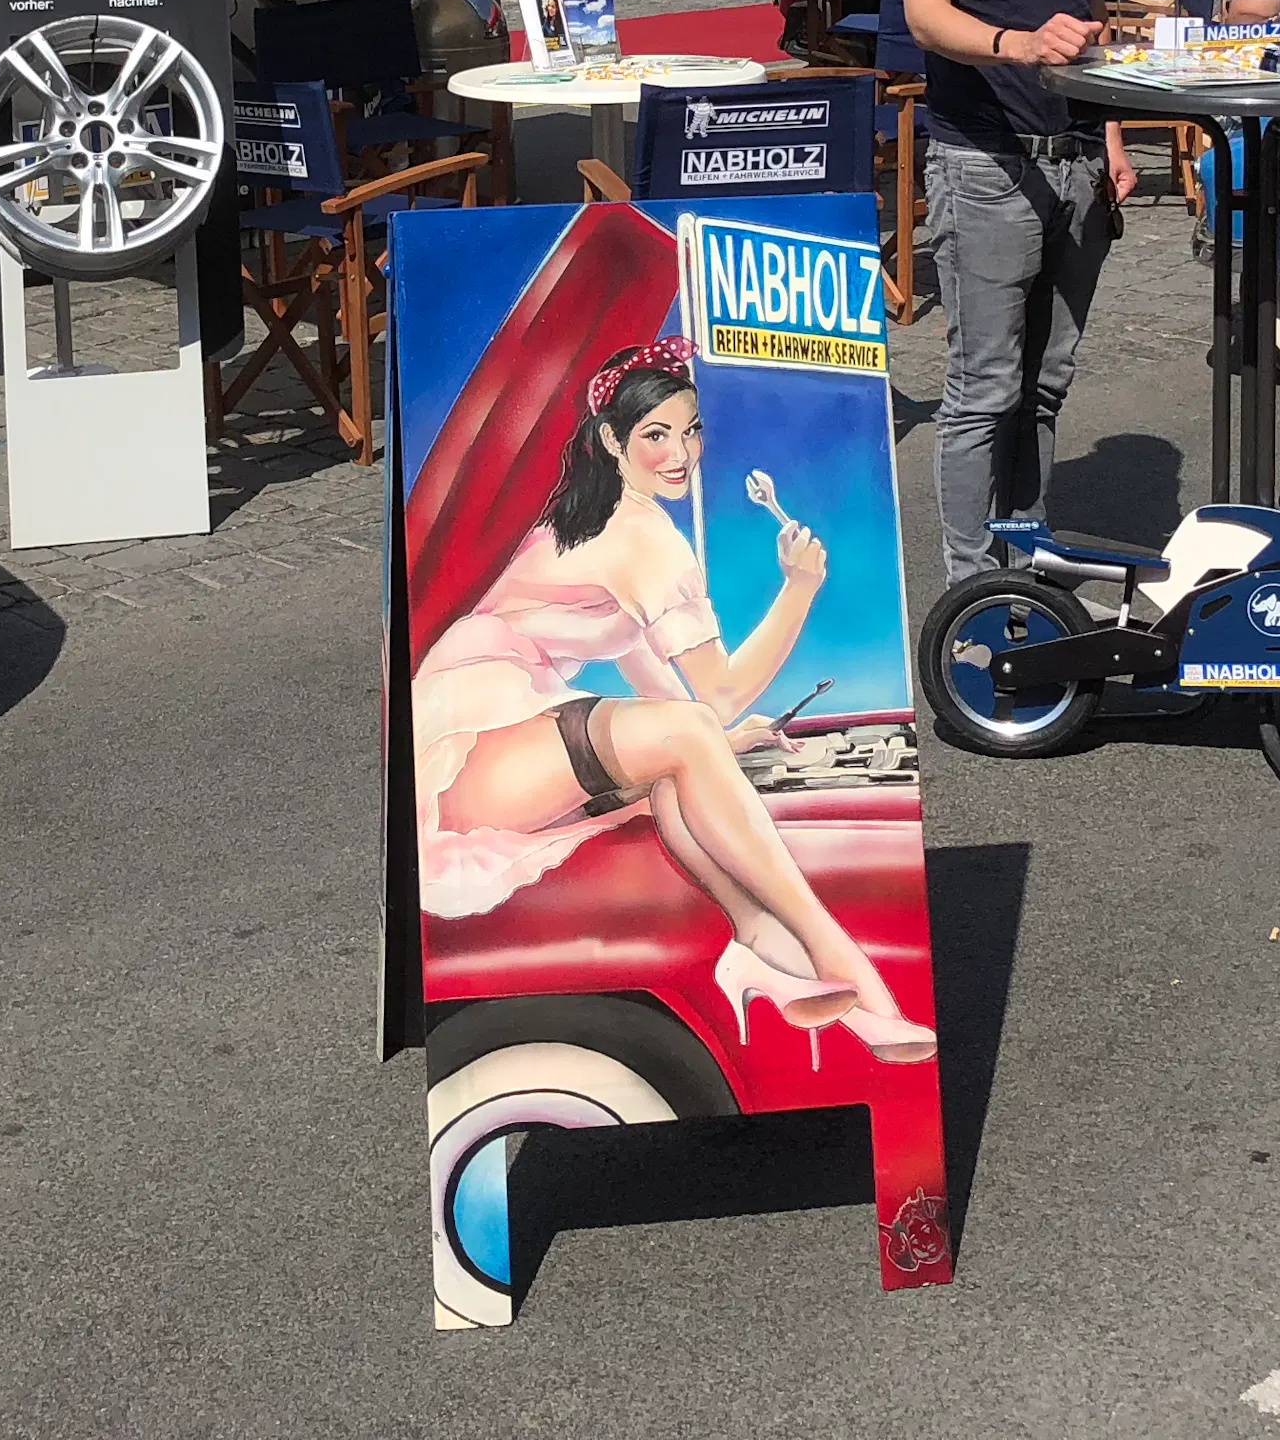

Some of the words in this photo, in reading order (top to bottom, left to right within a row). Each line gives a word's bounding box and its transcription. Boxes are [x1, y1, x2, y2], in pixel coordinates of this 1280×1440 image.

[9, 0, 54, 11] vorher:
[1206, 23, 1280, 41] NABHOLZ
[716, 107, 825, 125] MICHELIN
[236, 141, 303, 166] BHOLZ
[687, 146, 821, 173] NABHOLZ
[687, 173, 720, 182] REIFEN
[729, 169, 820, 180] FAHRWERK-SERVICE
[709, 233, 882, 335] NABHOLZ
[716, 329, 759, 356] REIFEN
[770, 333, 879, 368] FAHRWERK-SERVICE
